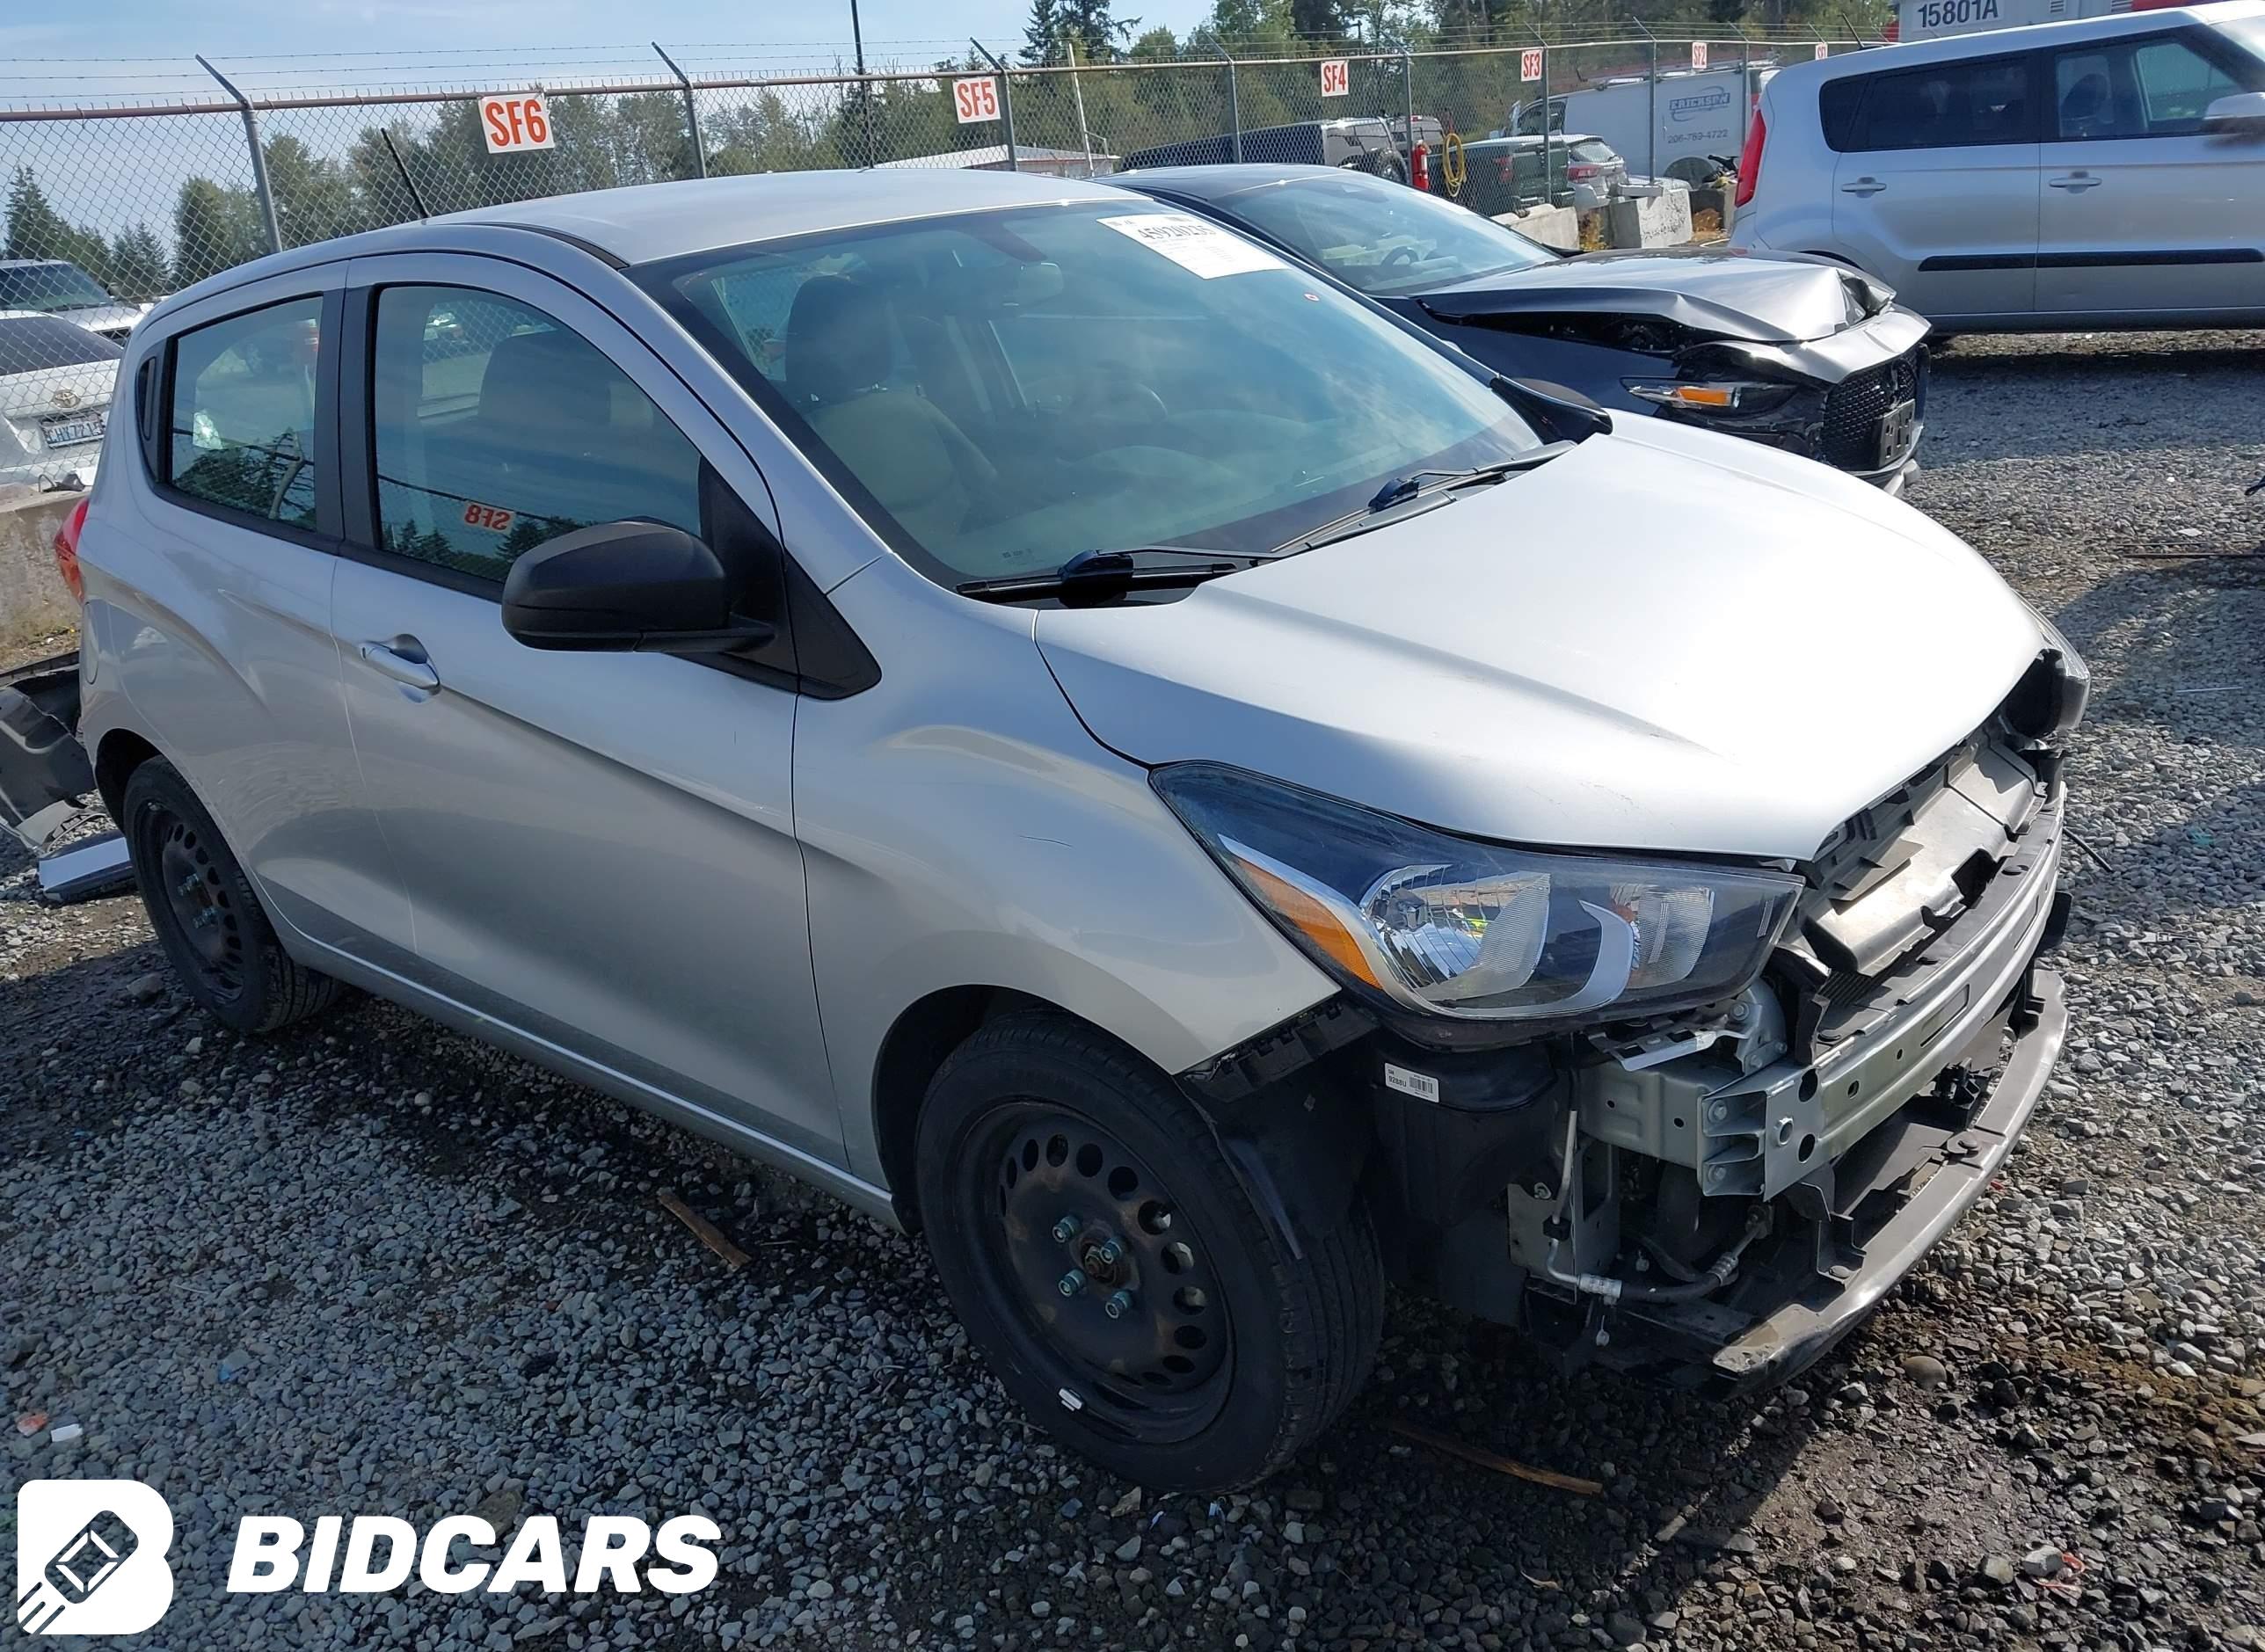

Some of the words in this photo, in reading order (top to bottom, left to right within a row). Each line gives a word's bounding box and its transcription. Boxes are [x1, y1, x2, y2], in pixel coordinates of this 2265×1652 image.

[1918, 0, 1999, 27] 15801A
[1323, 63, 1346, 92] SF4
[1523, 53, 1540, 77] SF3
[958, 81, 995, 118] SF5
[484, 98, 547, 147] SF6
